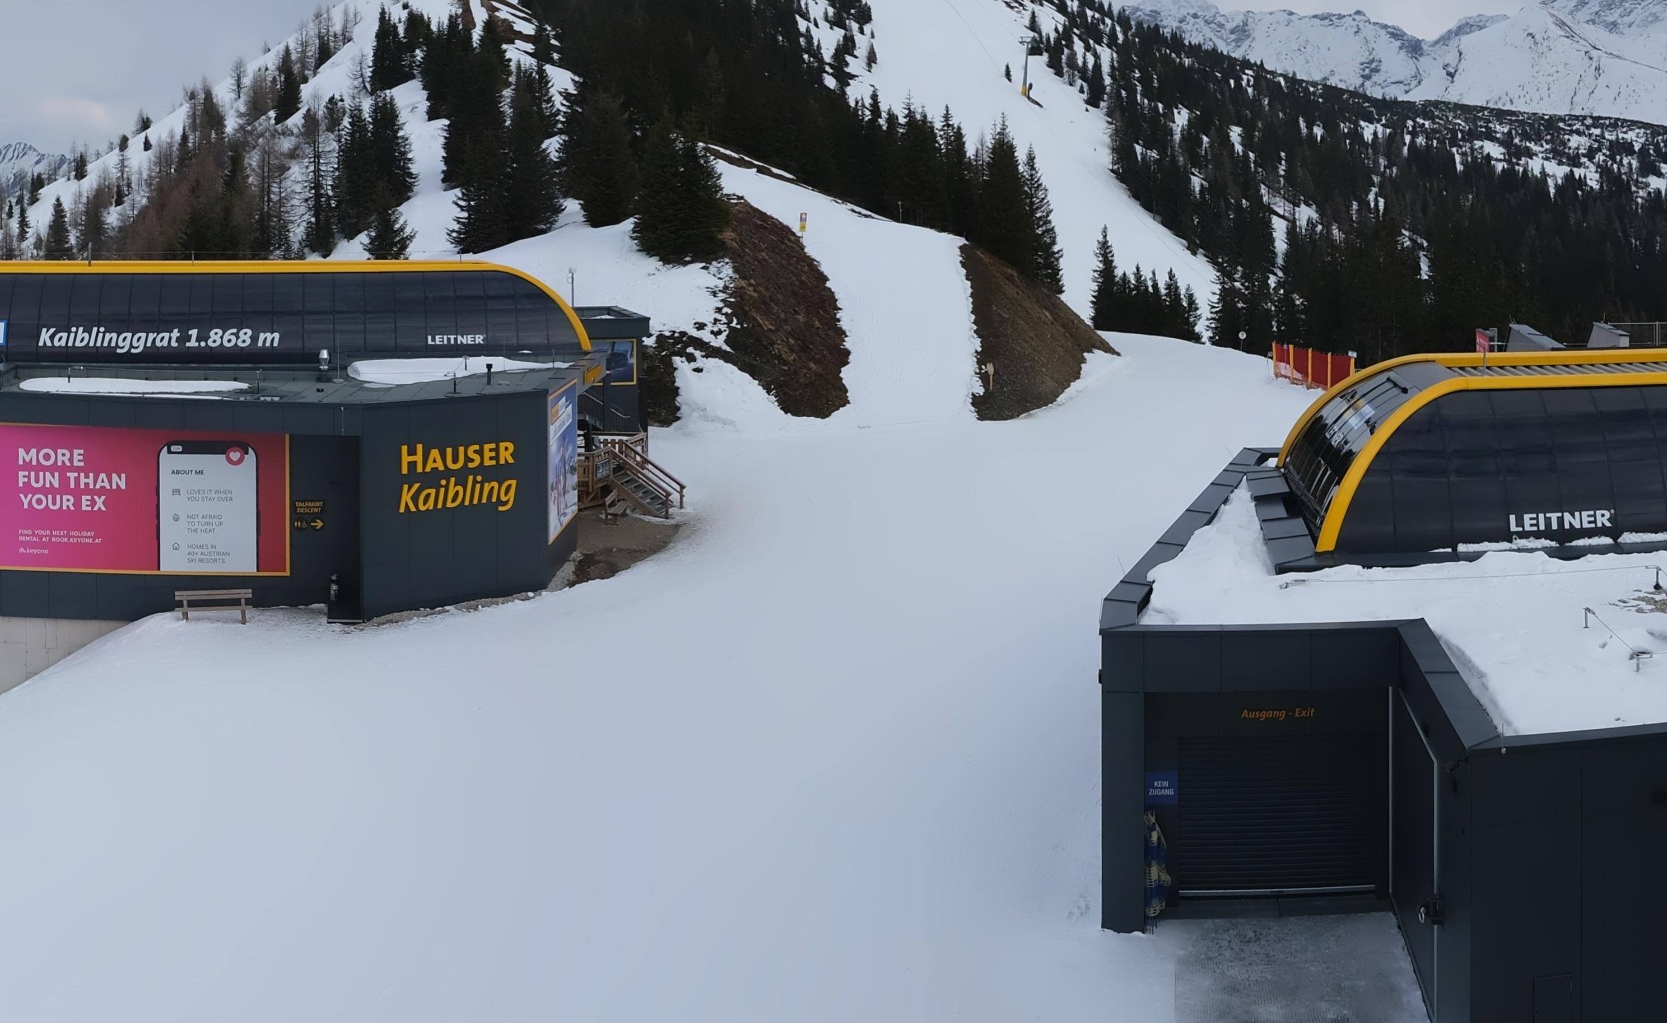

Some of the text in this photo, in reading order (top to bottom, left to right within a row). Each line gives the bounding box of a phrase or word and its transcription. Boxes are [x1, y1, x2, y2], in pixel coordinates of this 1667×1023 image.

[38, 326, 280, 353] Kaiblinggrat 1.868 m
[18, 448, 84, 466] MORE
[400, 441, 515, 475] HAUSER
[18, 471, 126, 490] FUN THAN
[20, 493, 107, 511] YOUR EX
[398, 475, 518, 513] Kaibling
[26, 547, 49, 555] keyone
[1241, 709, 1286, 721] Ausgang
[1295, 707, 1316, 717] Exit
[1148, 788, 1174, 796] ZUGANG
